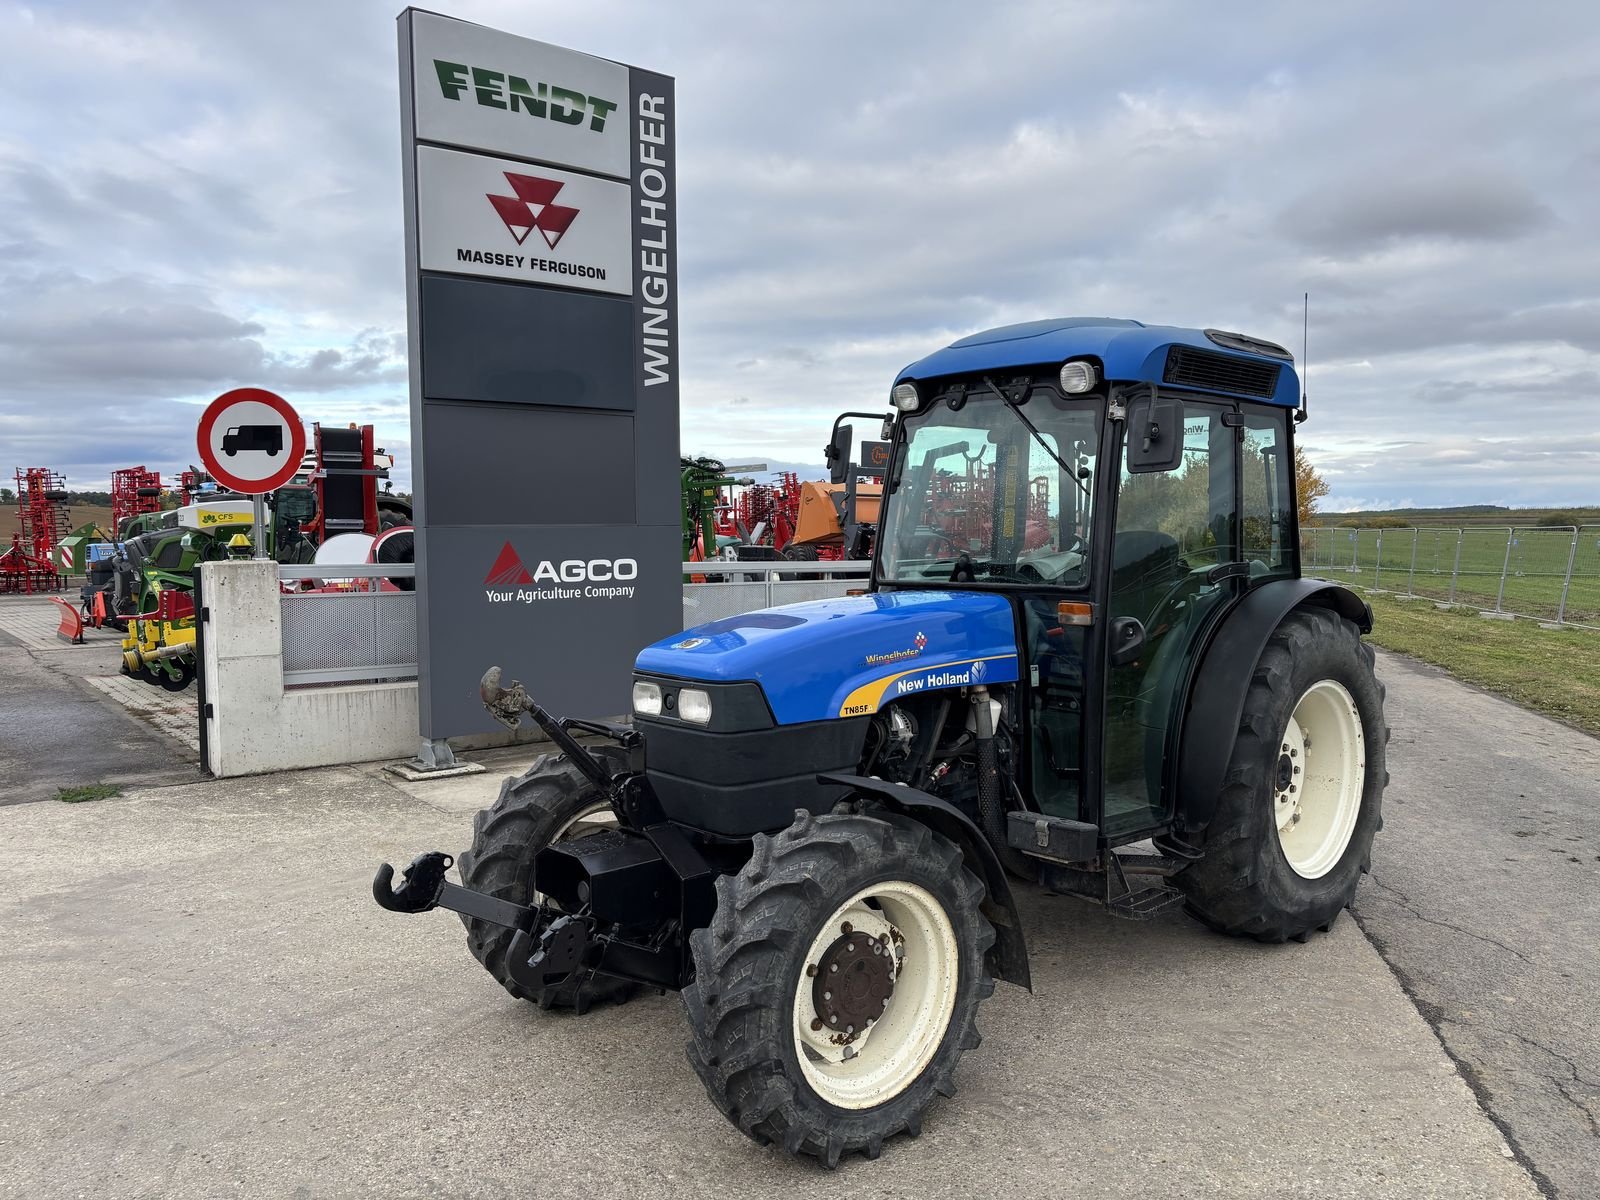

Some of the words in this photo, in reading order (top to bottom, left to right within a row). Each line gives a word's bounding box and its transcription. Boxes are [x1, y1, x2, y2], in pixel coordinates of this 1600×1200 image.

[433, 59, 618, 133] FENDT
[639, 92, 670, 387] WINGELHOFER
[457, 248, 525, 269] MASSEY
[530, 258, 606, 281] FERGUSON
[217, 513, 234, 521] CFS
[533, 558, 638, 584] AGCO
[486, 590, 513, 603] Your
[516, 587, 581, 604] Agriculture
[584, 586, 635, 600] Company
[897, 679, 924, 693] New
[927, 672, 969, 687] Holland
